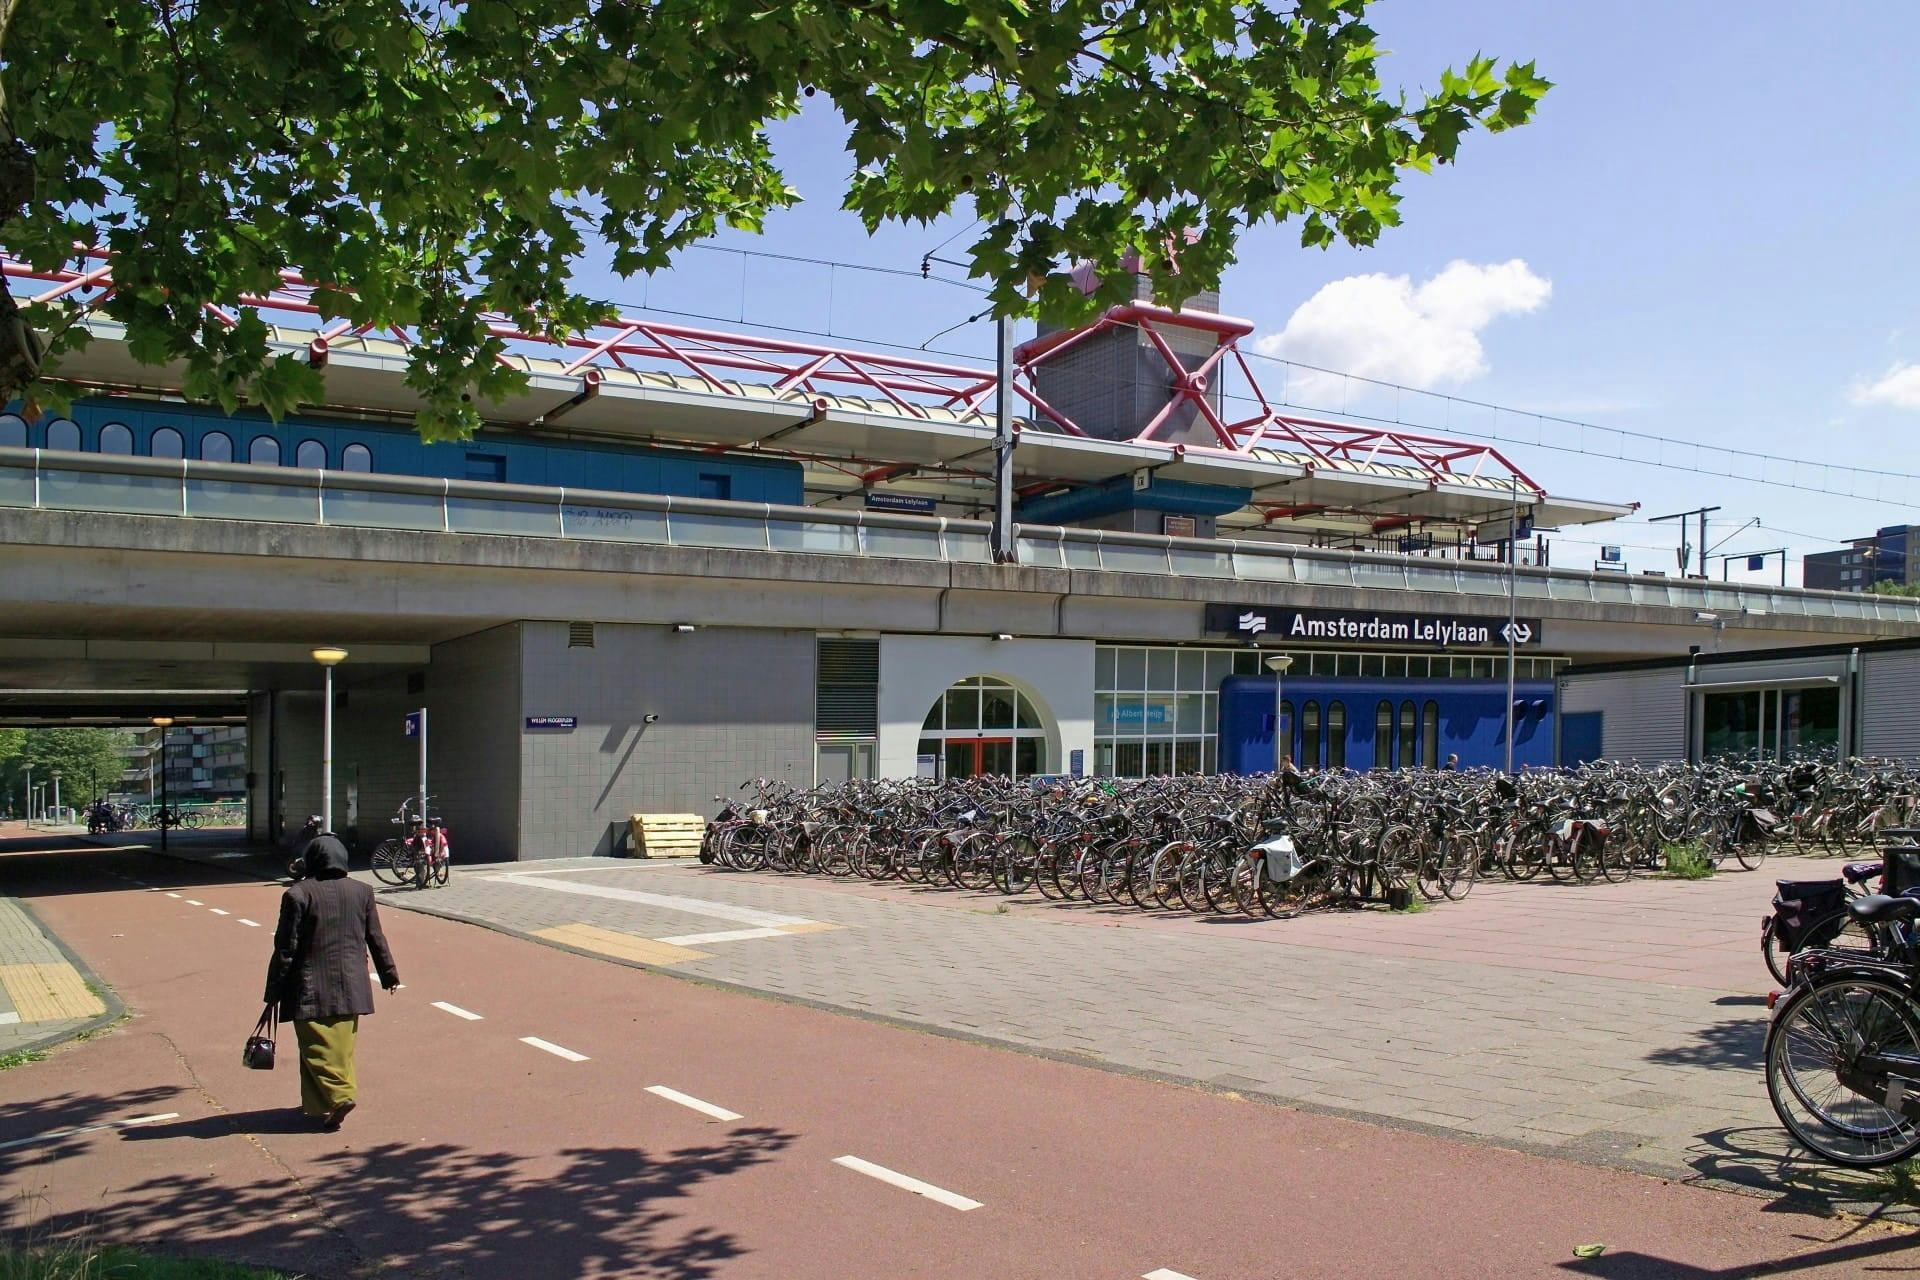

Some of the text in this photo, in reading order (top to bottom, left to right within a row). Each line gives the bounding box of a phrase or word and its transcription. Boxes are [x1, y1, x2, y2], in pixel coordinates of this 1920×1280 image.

[871, 496, 904, 504] Amsterdam
[1291, 613, 1489, 645] Amsterdam Lelylaan
